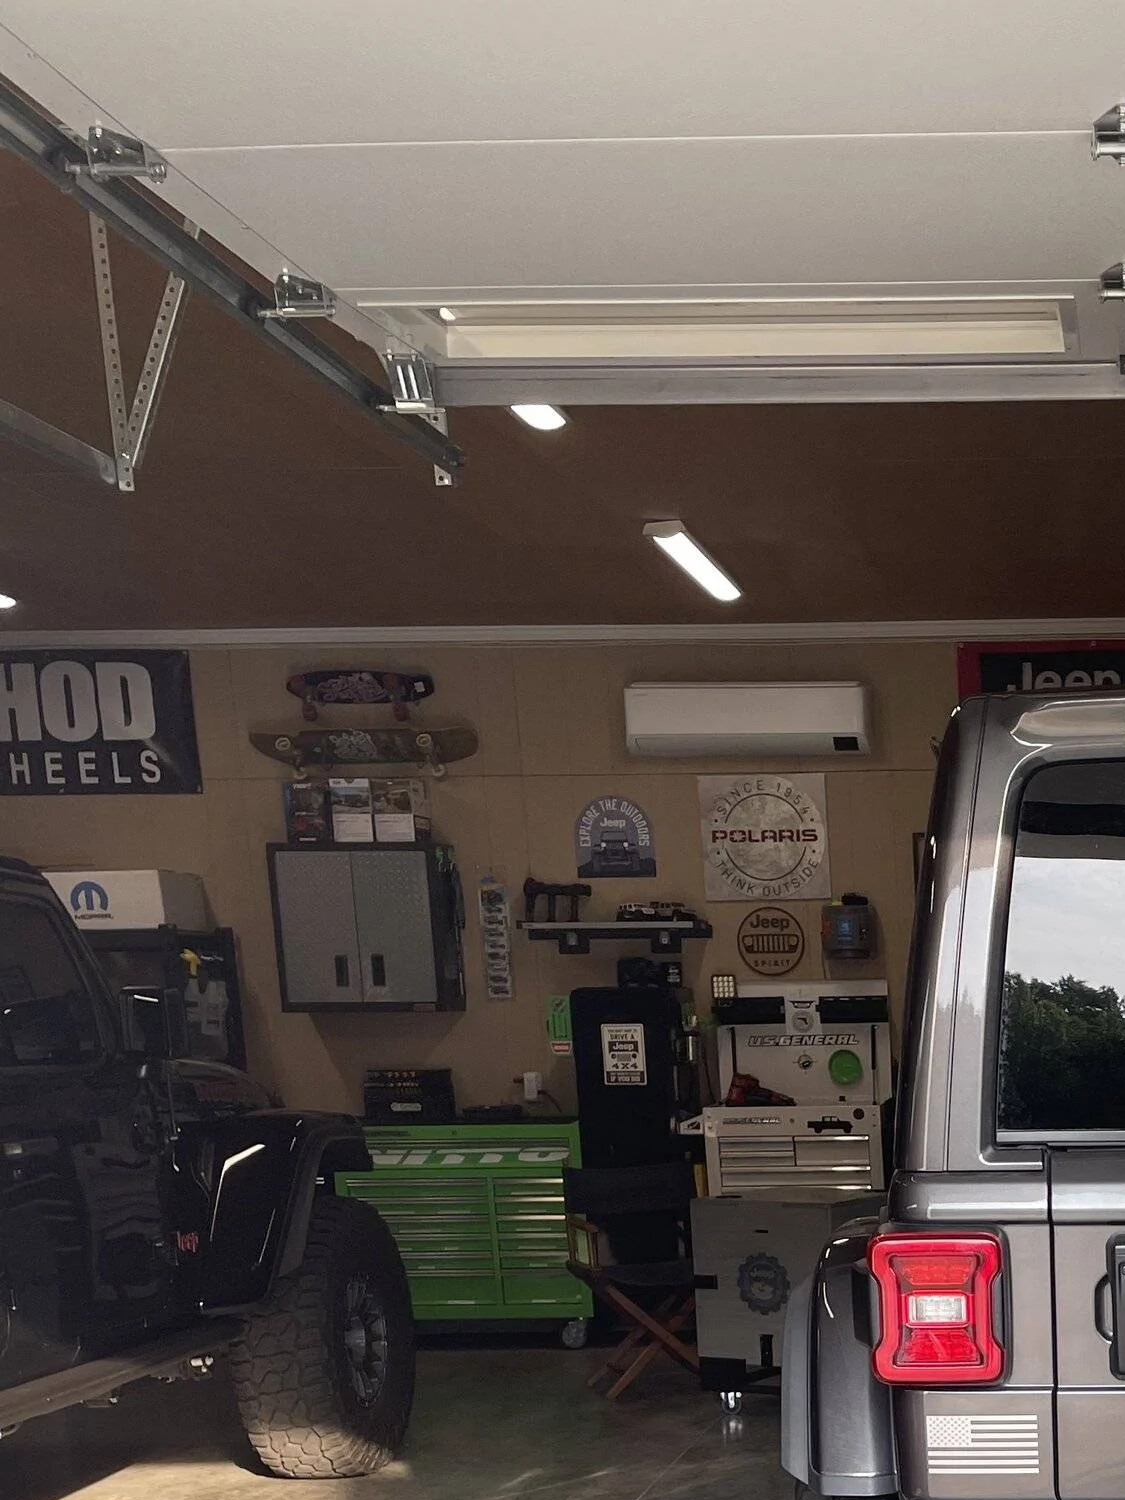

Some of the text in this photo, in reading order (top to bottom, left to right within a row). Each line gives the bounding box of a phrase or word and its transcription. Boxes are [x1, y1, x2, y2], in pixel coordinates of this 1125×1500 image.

[8, 748, 162, 784] HEELS
[716, 780, 810, 816] SINCE 1954
[578, 798, 650, 847] EXPLORE THE OUTDOORS
[599, 816, 626, 829] Jeep
[712, 829, 818, 843] POLARIS
[715, 858, 819, 897] THINK OUTSIDE
[750, 914, 790, 932] Jeep
[753, 959, 791, 968] SPIRIT
[612, 1041, 635, 1051] Jeep
